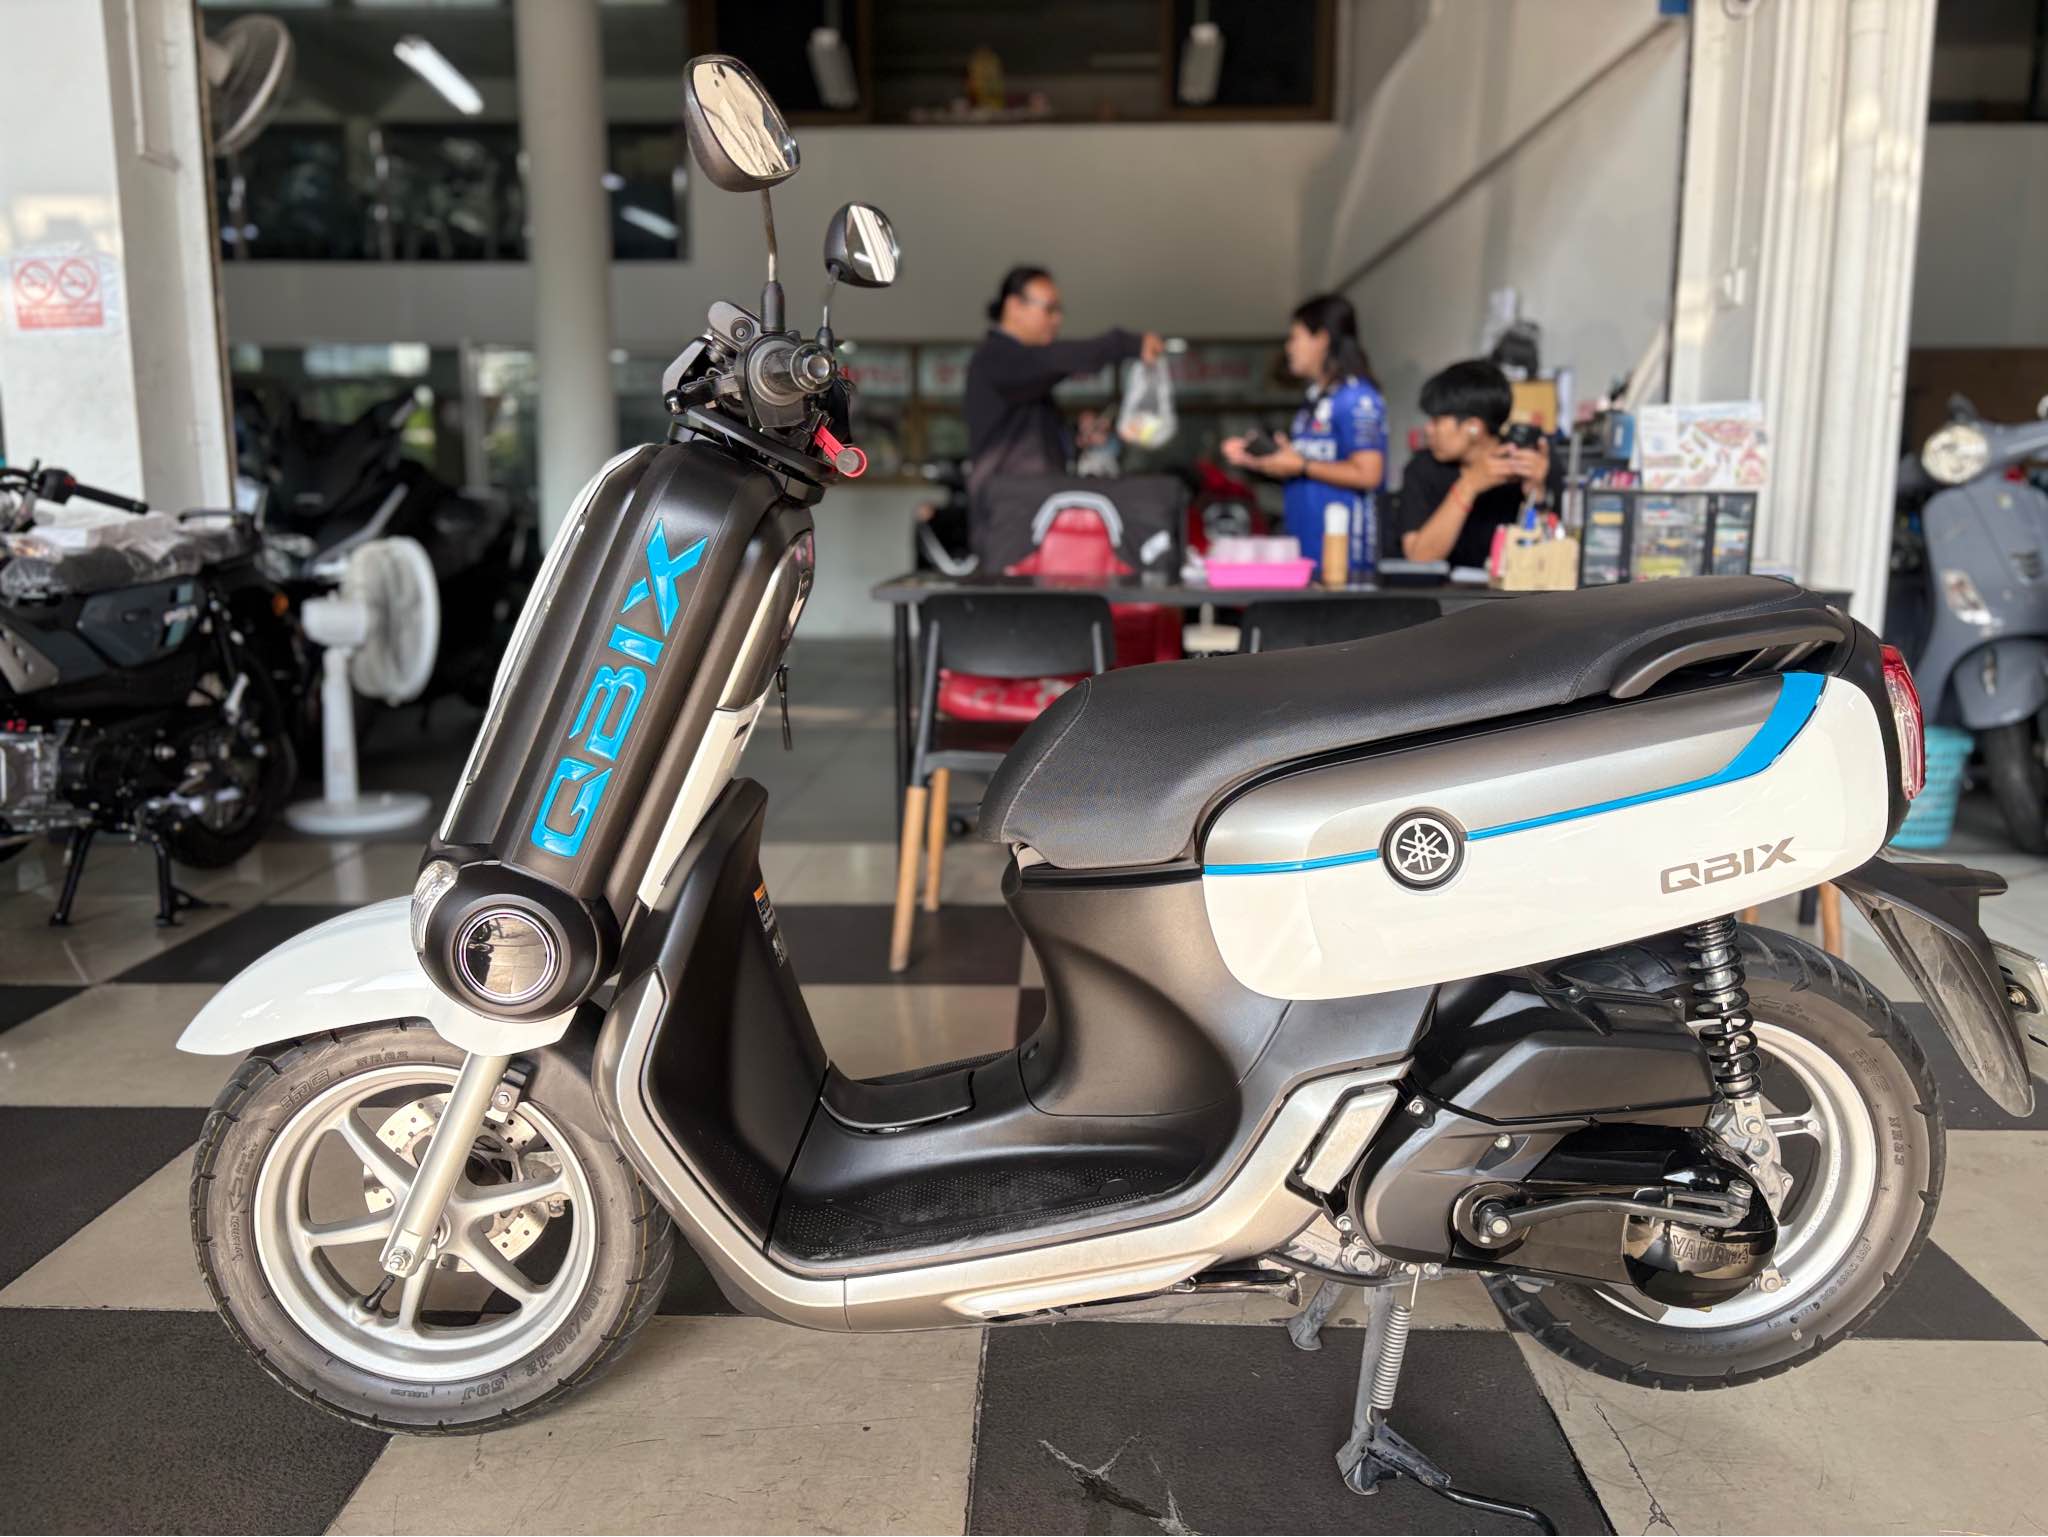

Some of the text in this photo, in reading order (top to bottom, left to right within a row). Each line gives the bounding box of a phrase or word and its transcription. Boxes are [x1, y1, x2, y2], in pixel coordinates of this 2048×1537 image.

[531, 519, 708, 857] QBIX
[1660, 836, 1797, 894] QBIX
[1672, 1234, 1750, 1264] YAMAHA
